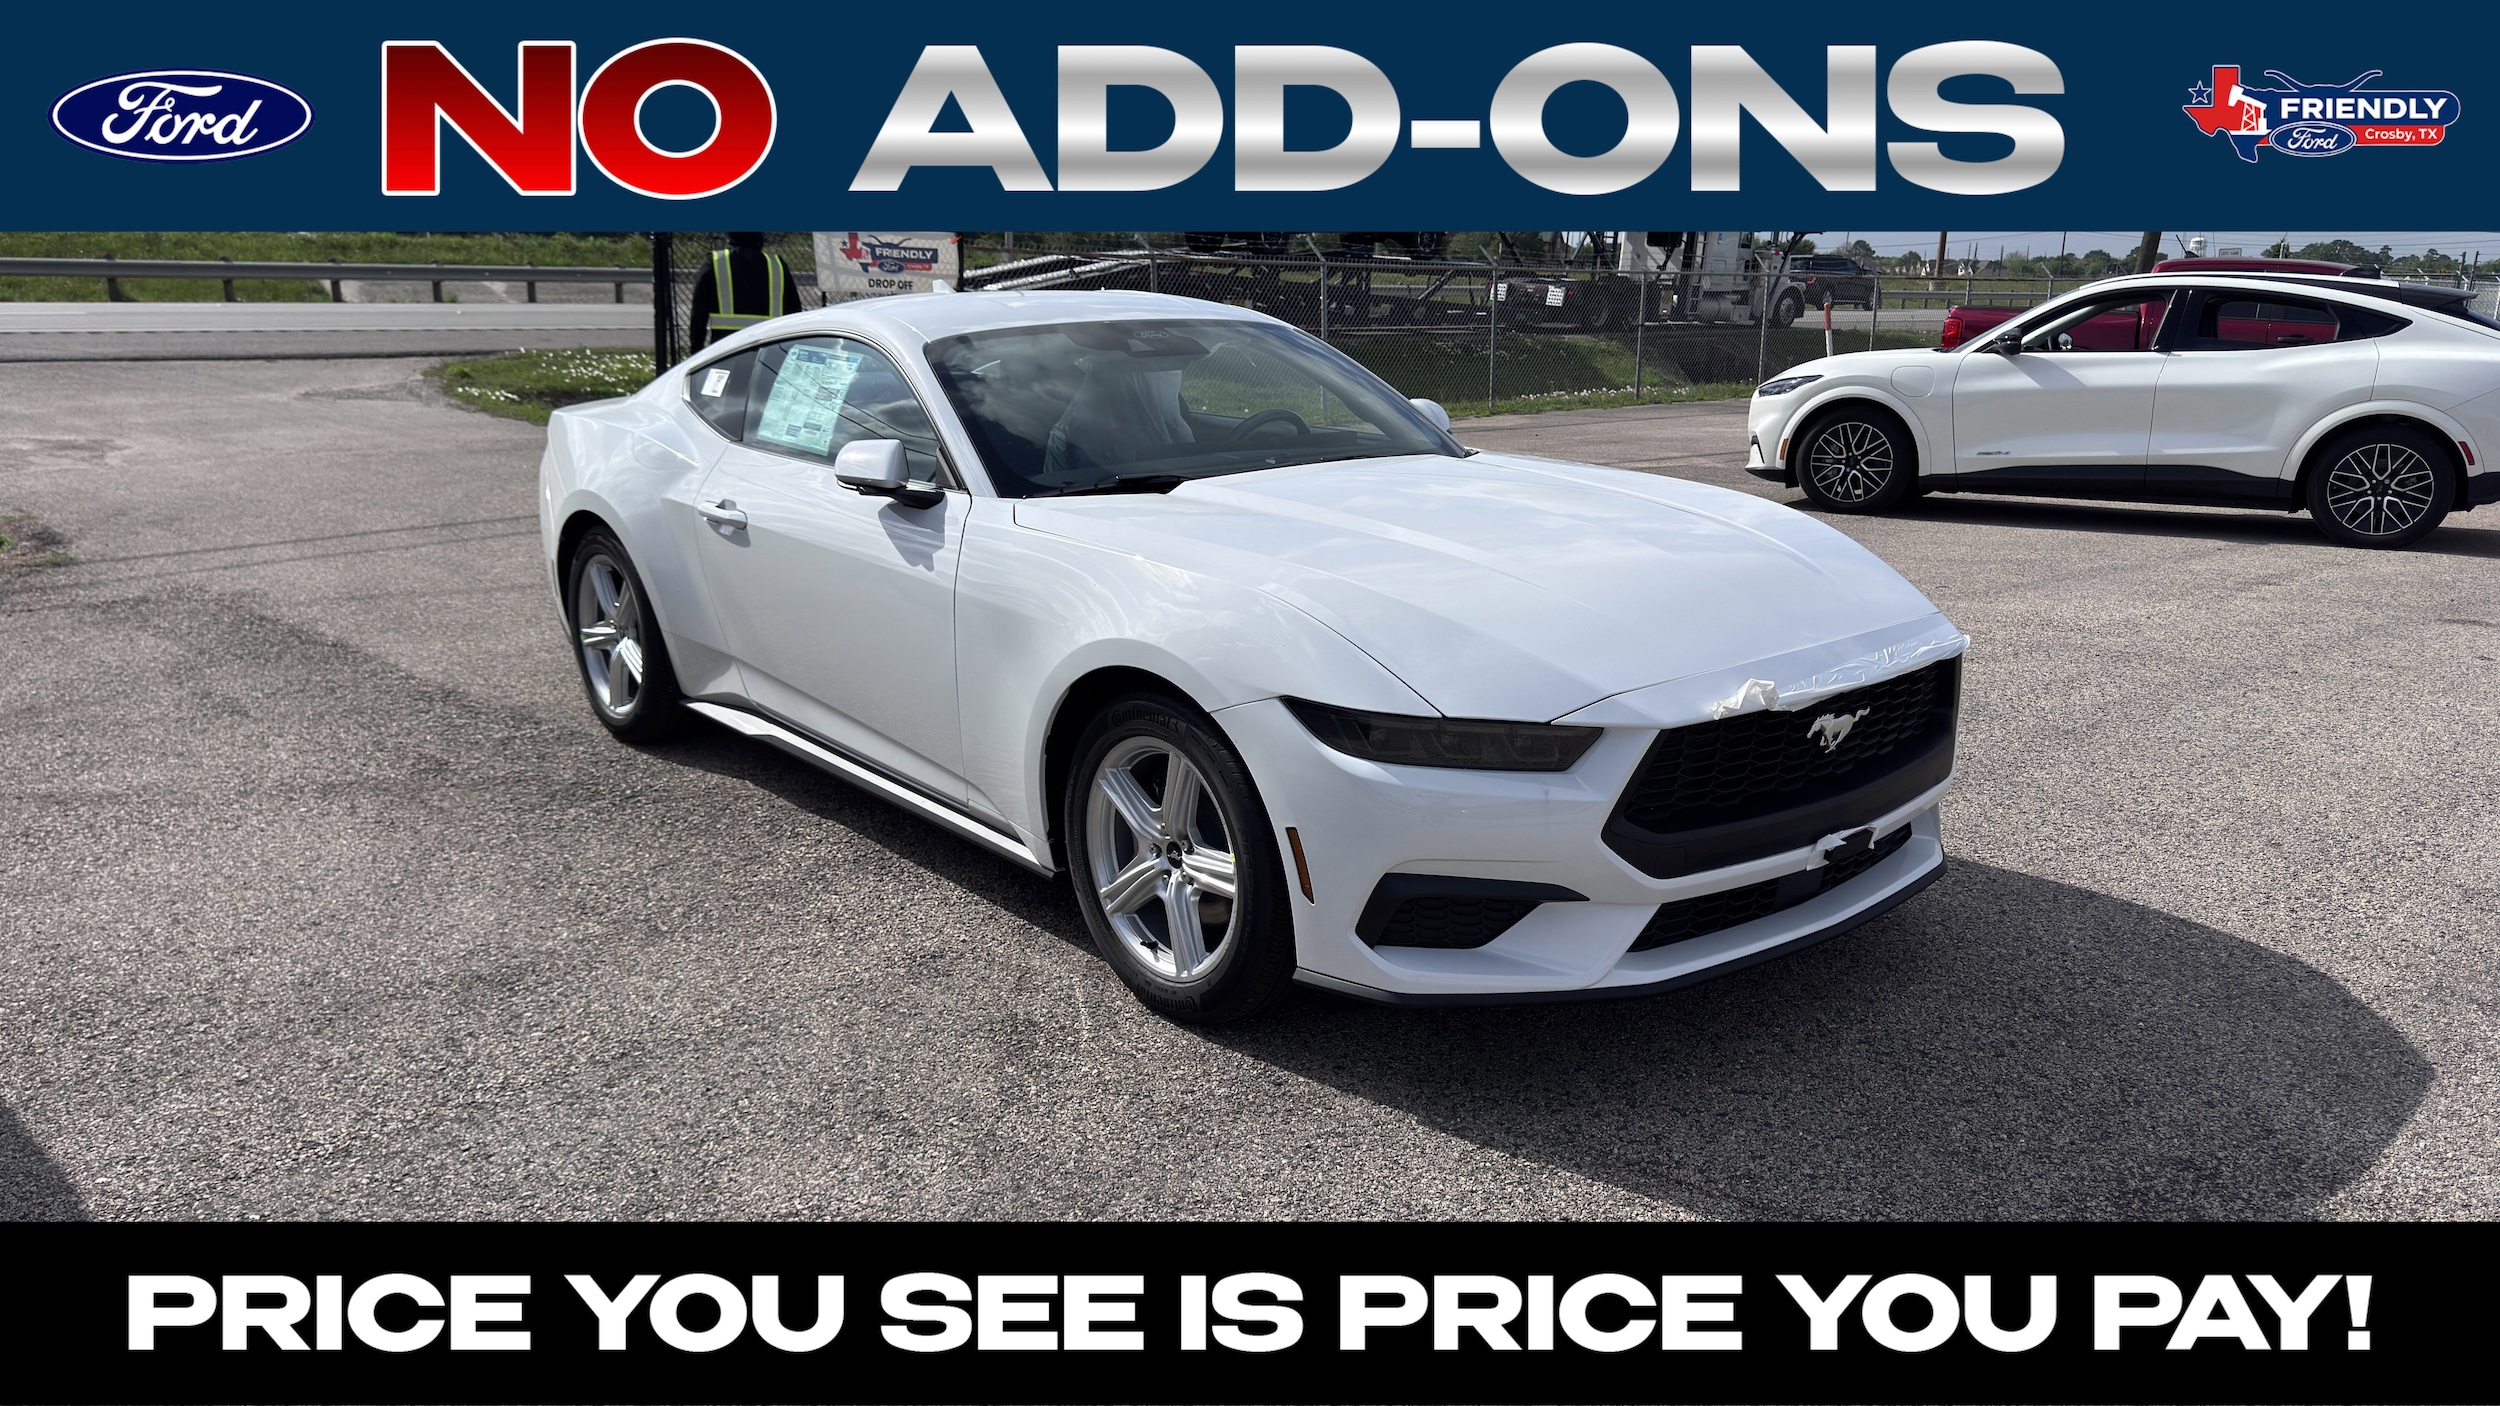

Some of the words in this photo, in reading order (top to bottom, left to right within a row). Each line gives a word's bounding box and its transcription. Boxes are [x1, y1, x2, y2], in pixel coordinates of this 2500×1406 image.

[875, 247, 933, 260] FRIENDLY
[882, 260, 900, 272] Ford
[868, 279, 895, 289] DROP
[897, 280, 914, 290] OFF
[1111, 706, 1170, 728] Continental
